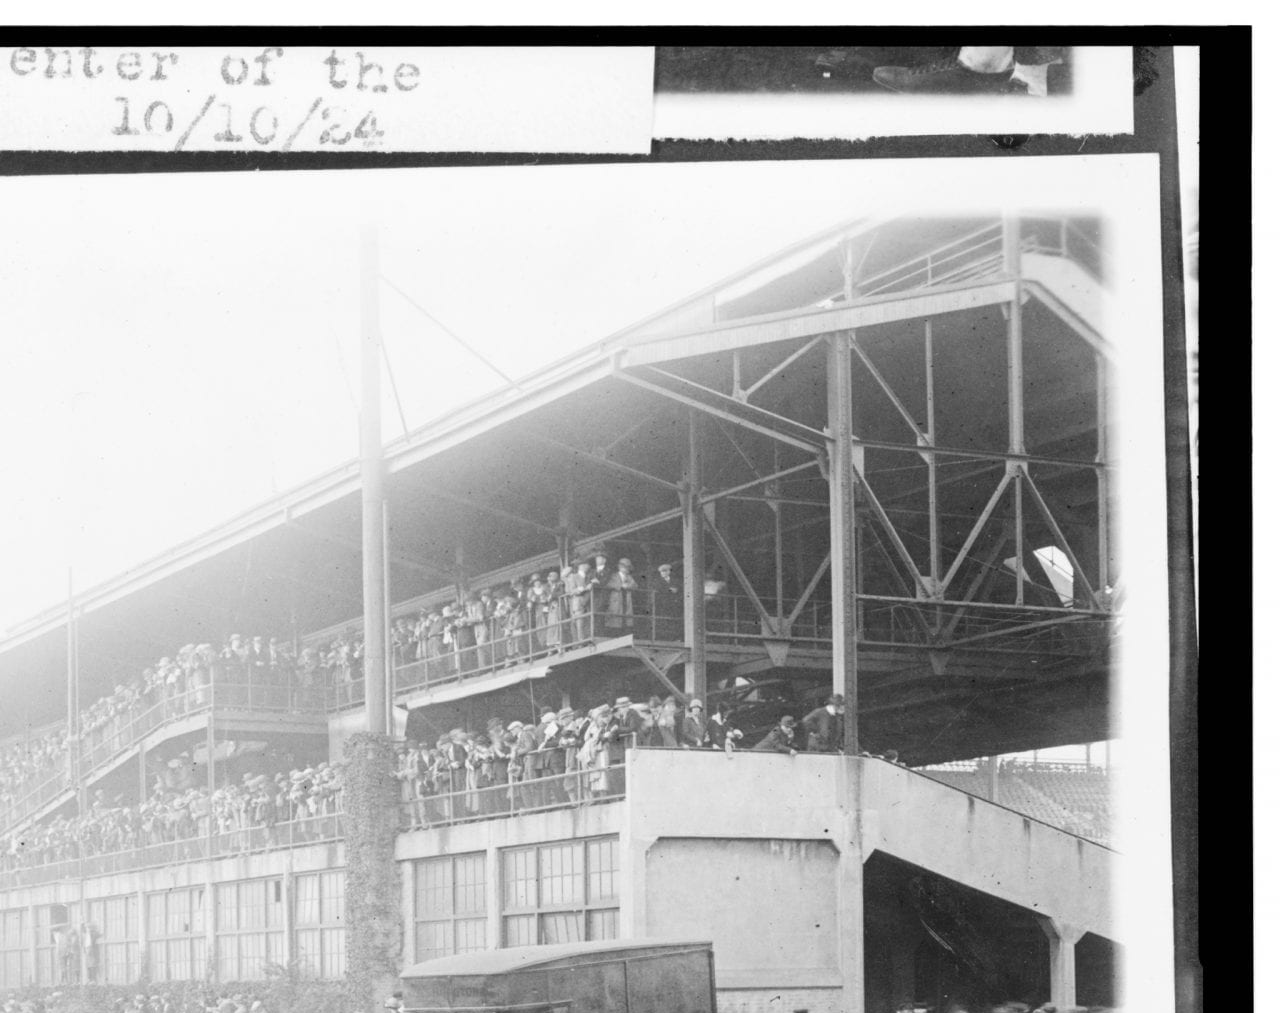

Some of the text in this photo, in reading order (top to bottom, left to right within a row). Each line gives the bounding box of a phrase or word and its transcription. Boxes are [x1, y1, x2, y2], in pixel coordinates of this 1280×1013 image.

[220, 48, 284, 86] of
[323, 49, 420, 94] the
[111, 94, 386, 150] 10/10/24
